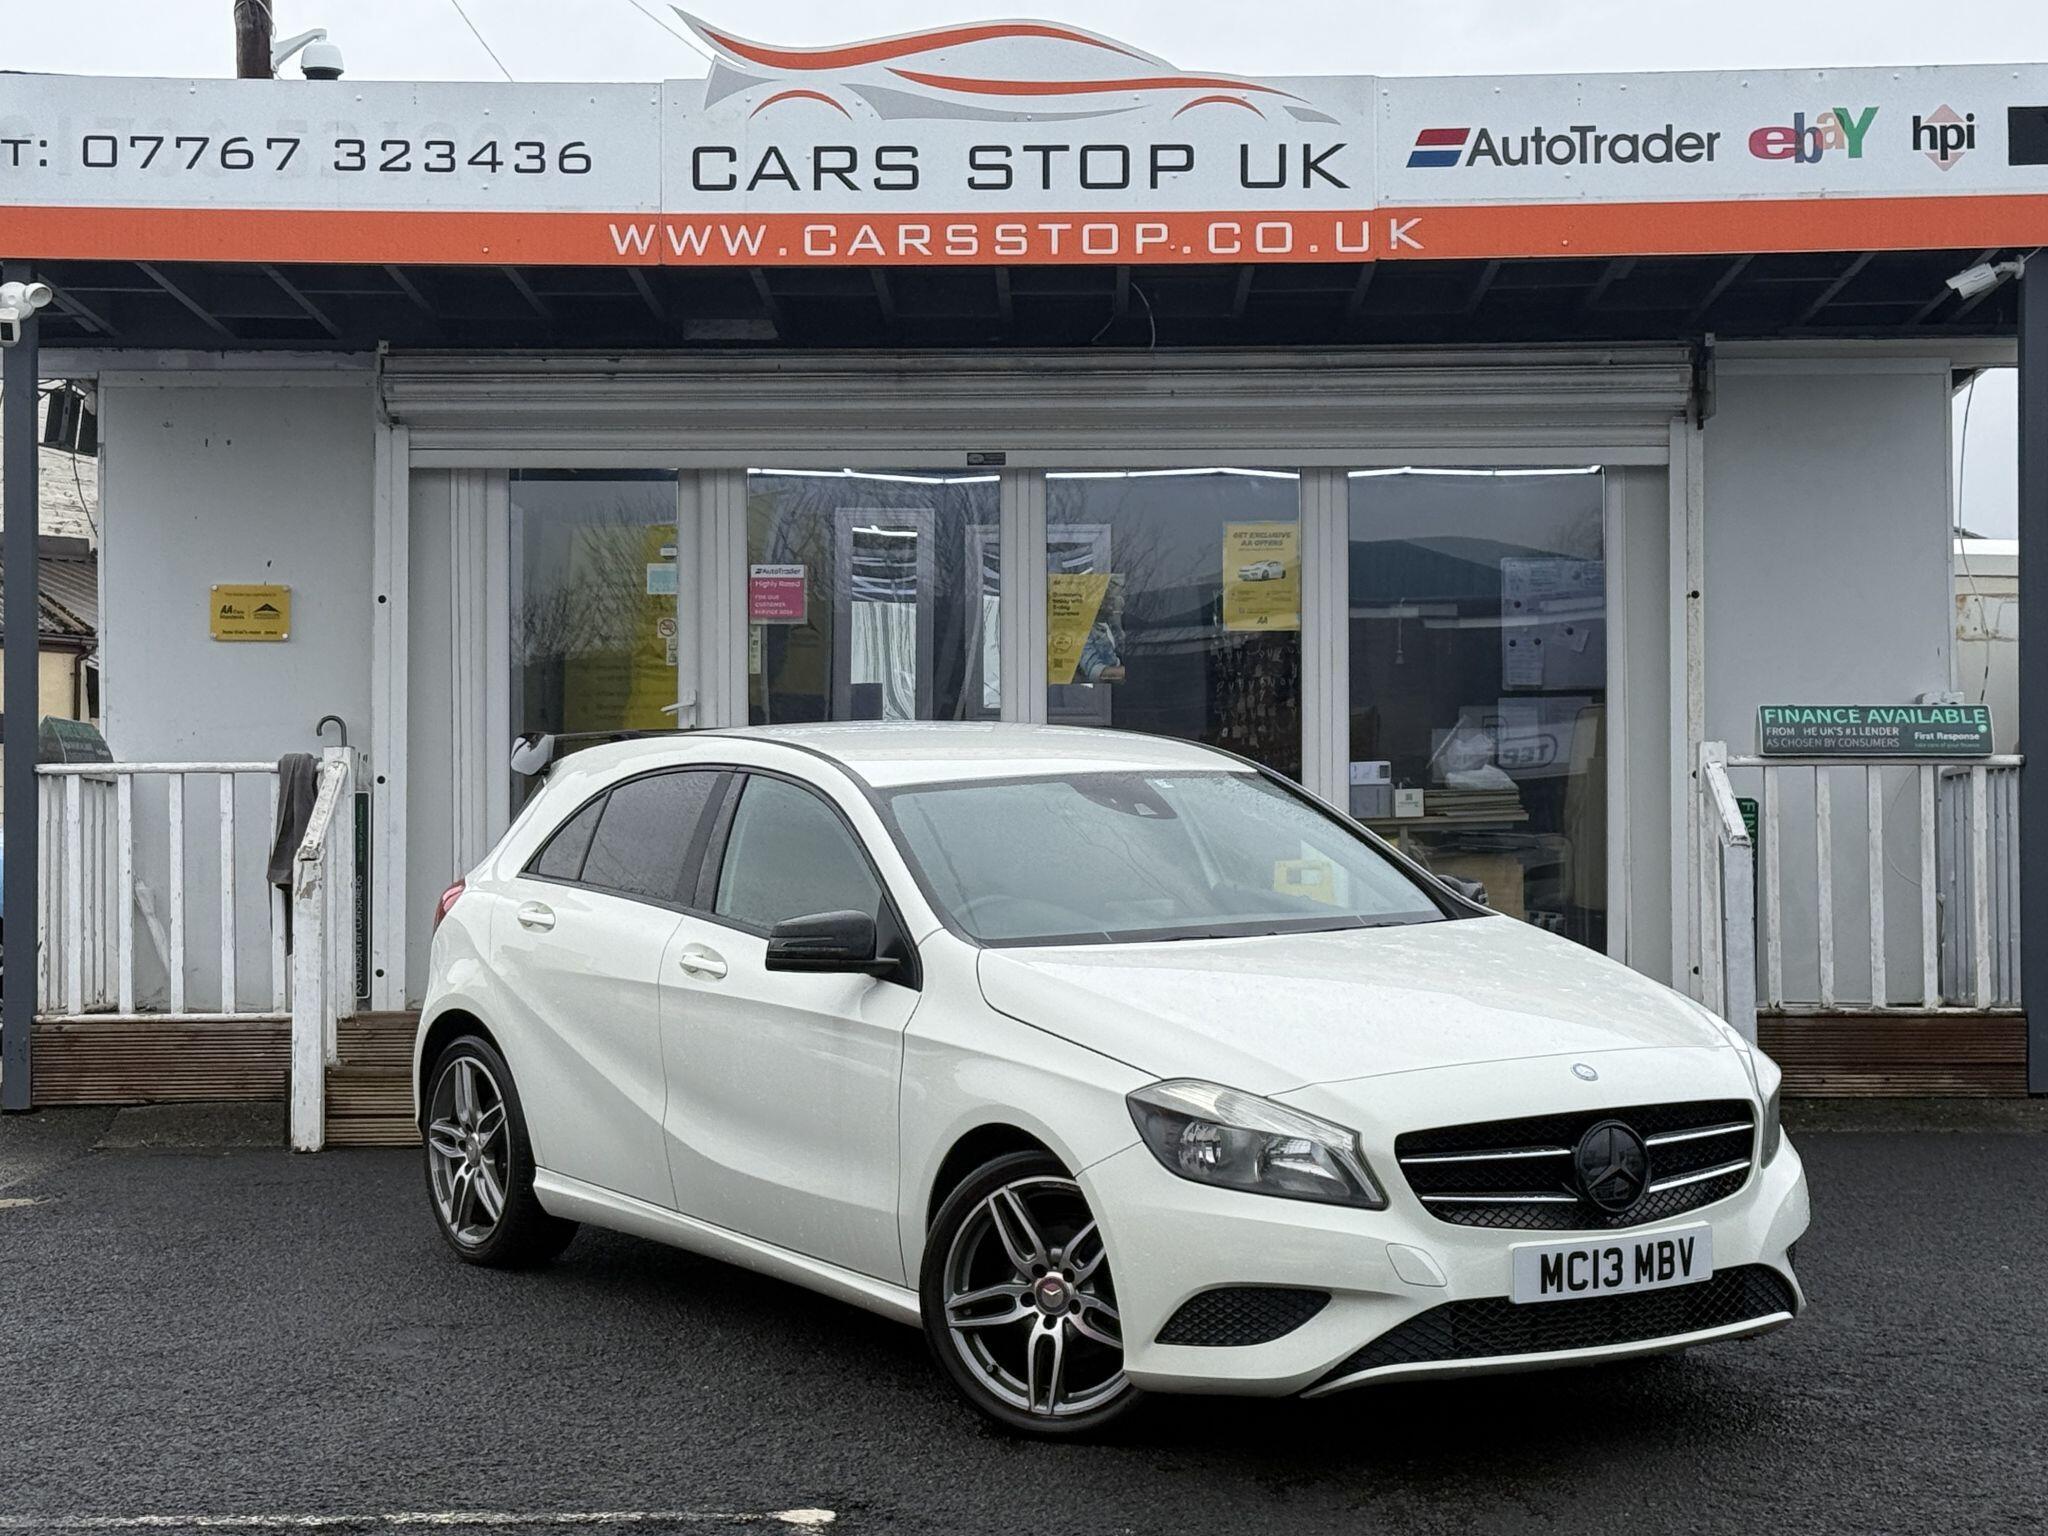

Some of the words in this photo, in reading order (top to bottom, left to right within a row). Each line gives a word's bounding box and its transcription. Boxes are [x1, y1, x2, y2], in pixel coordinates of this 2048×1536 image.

[0, 137, 48, 168] T:
[82, 135, 301, 170] 07767
[333, 138, 593, 175] 323436
[1465, 122, 1722, 168] AutoTrader
[1912, 112, 1976, 162] hpi
[692, 145, 921, 192] CARS
[966, 143, 1195, 190] STOP
[1239, 143, 1351, 189] UK
[608, 217, 1426, 257] WWW.CARSSTOP.CO.UK
[1764, 708, 1862, 724] FINANCE
[1867, 708, 1988, 724] AVAILABLE
[1766, 727, 1796, 736] FROM
[1820, 727, 1843, 736] UK'S
[1859, 727, 1900, 736] LENDER
[1766, 738, 1779, 747] AS
[1781, 738, 1822, 747] CHOSEN
[1824, 738, 1837, 747] BY
[1839, 738, 1900, 747] CONSUMERS
[1914, 731, 1935, 740] First
[1936, 731, 1981, 742] Response
[1540, 1247, 1623, 1294] MC13
[1634, 1236, 1695, 1285] MBV
